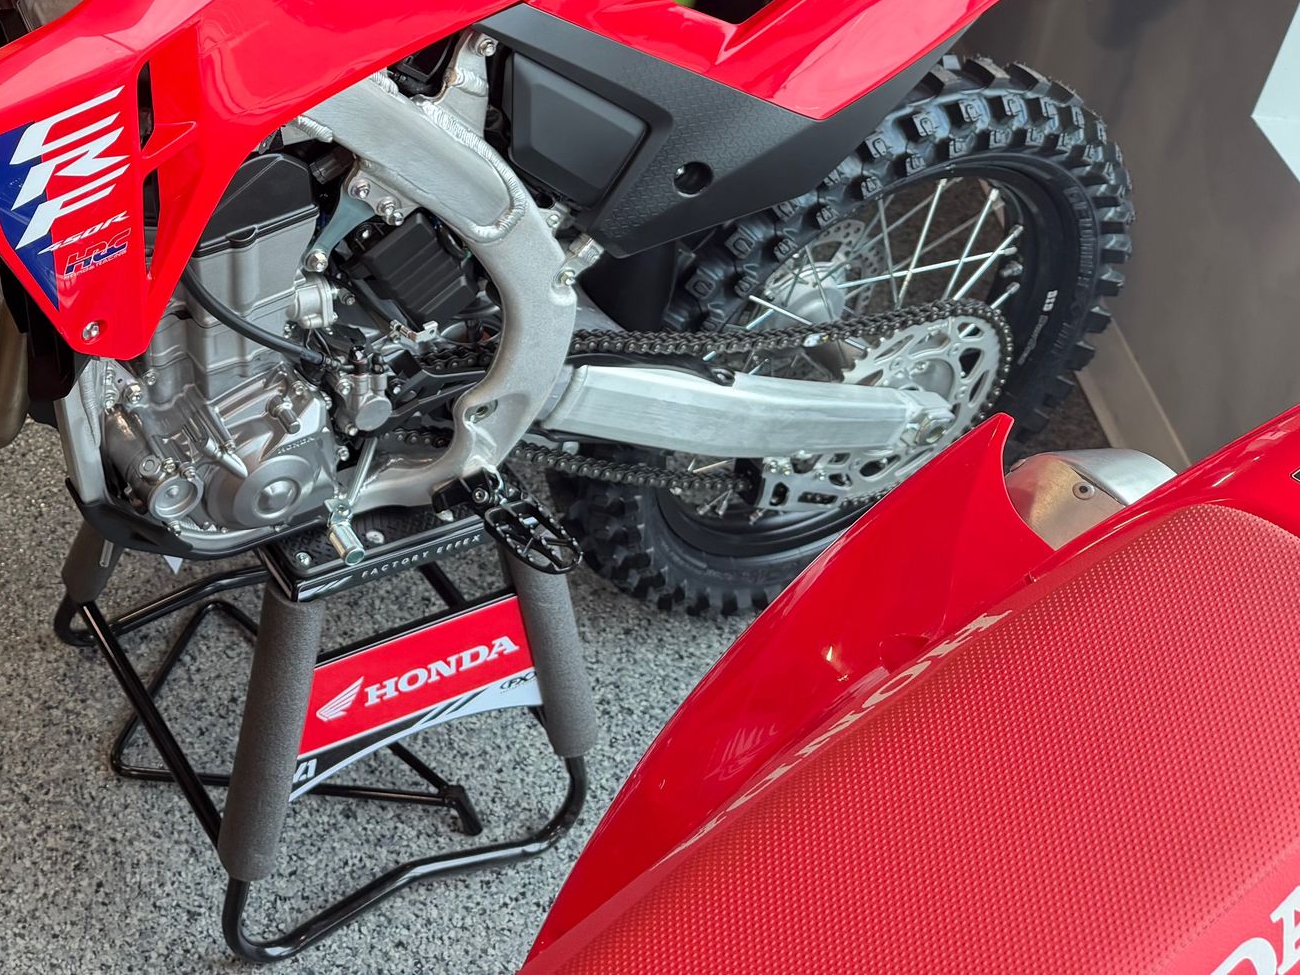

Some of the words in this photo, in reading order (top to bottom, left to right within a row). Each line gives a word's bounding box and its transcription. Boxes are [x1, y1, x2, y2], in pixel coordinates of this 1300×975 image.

[9, 85, 132, 250] CRF
[64, 227, 132, 276] HRC
[361, 550, 431, 579] FACTORY
[436, 533, 481, 555] EFFEX
[363, 635, 520, 708] HONDA
